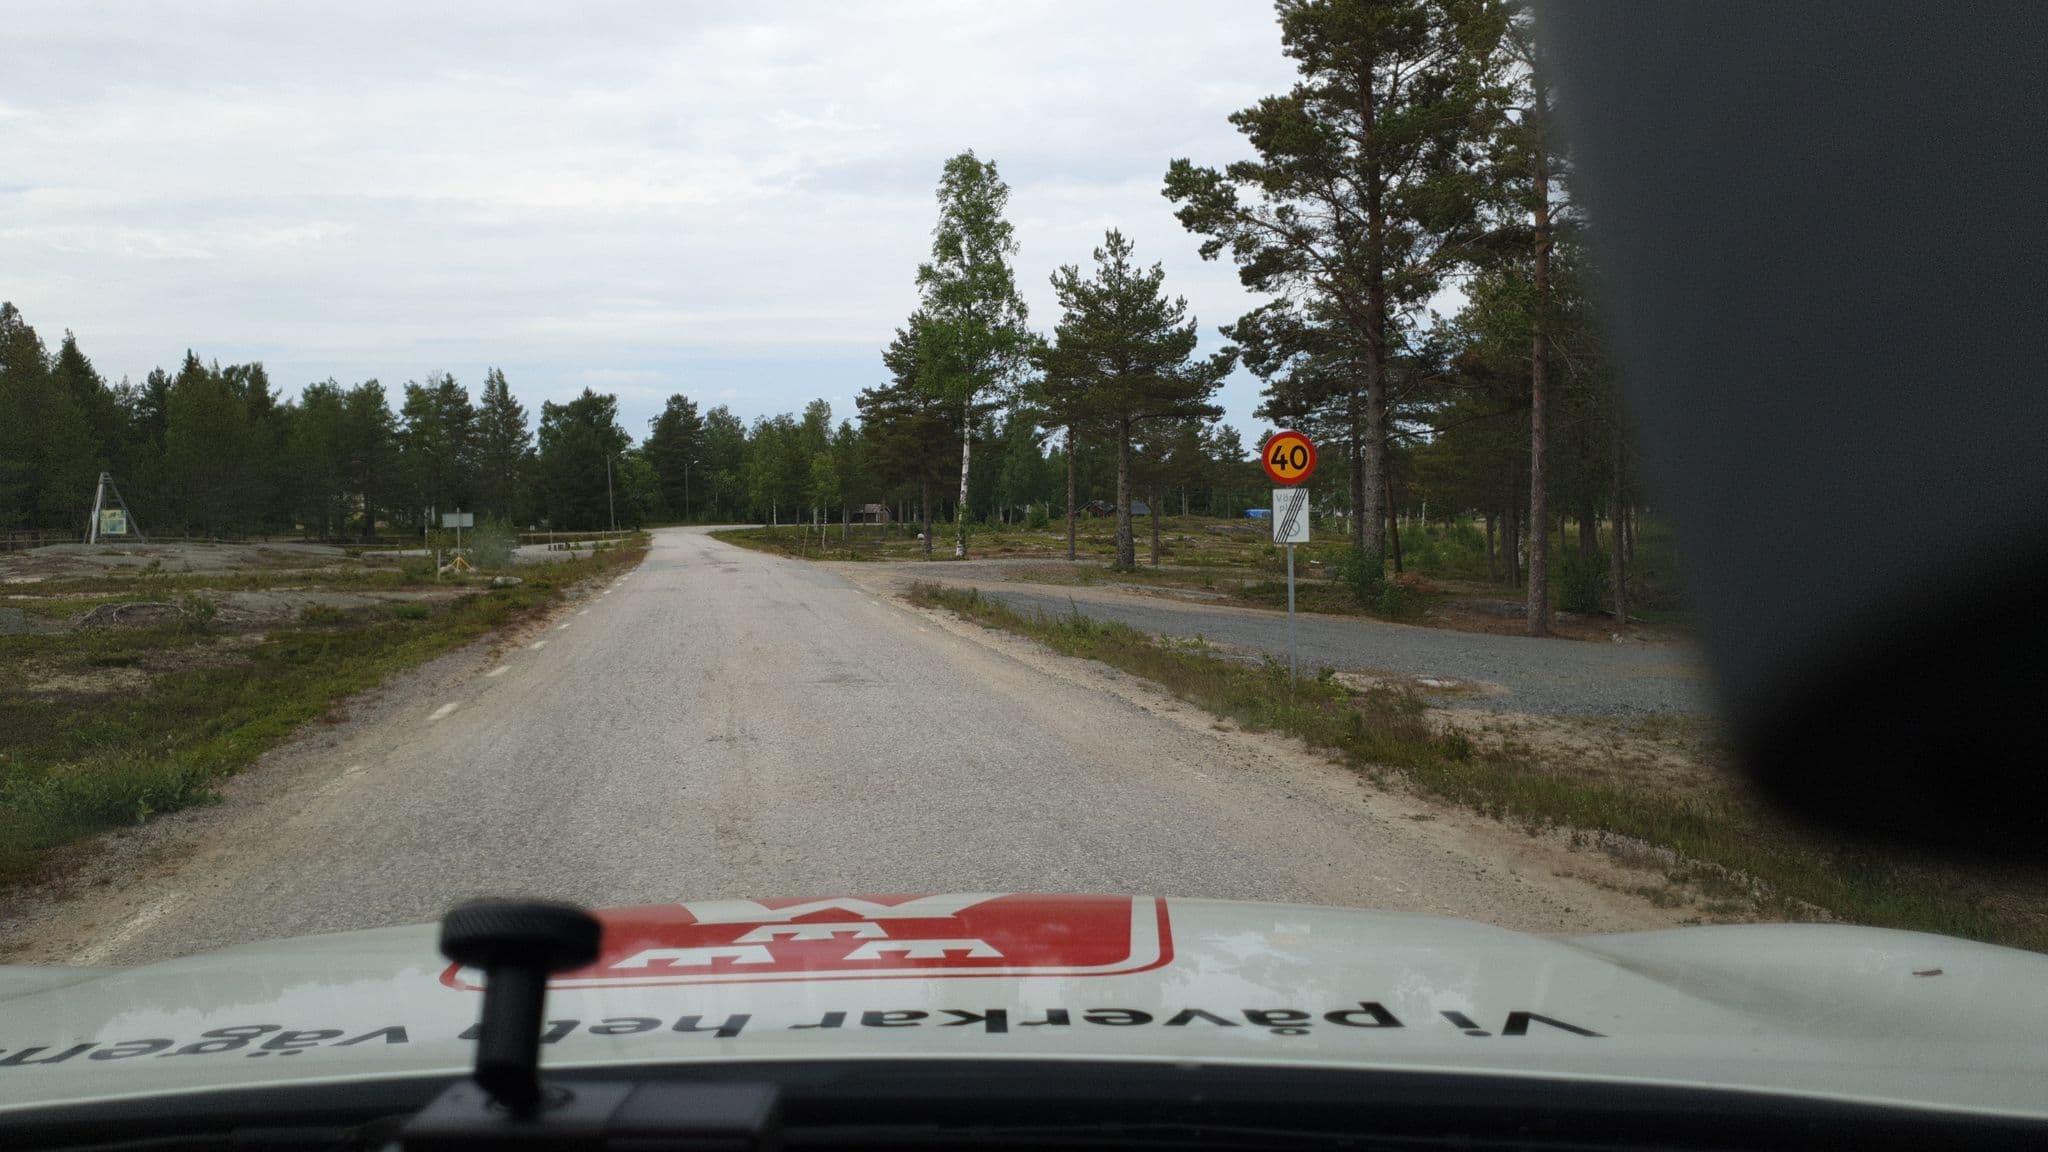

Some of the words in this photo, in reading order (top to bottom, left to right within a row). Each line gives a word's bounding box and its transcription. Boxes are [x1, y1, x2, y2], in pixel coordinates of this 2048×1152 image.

[1271, 445, 1308, 471] 40
[787, 1001, 1406, 1036] påverkar
[1438, 1010, 1608, 1037] Vi
